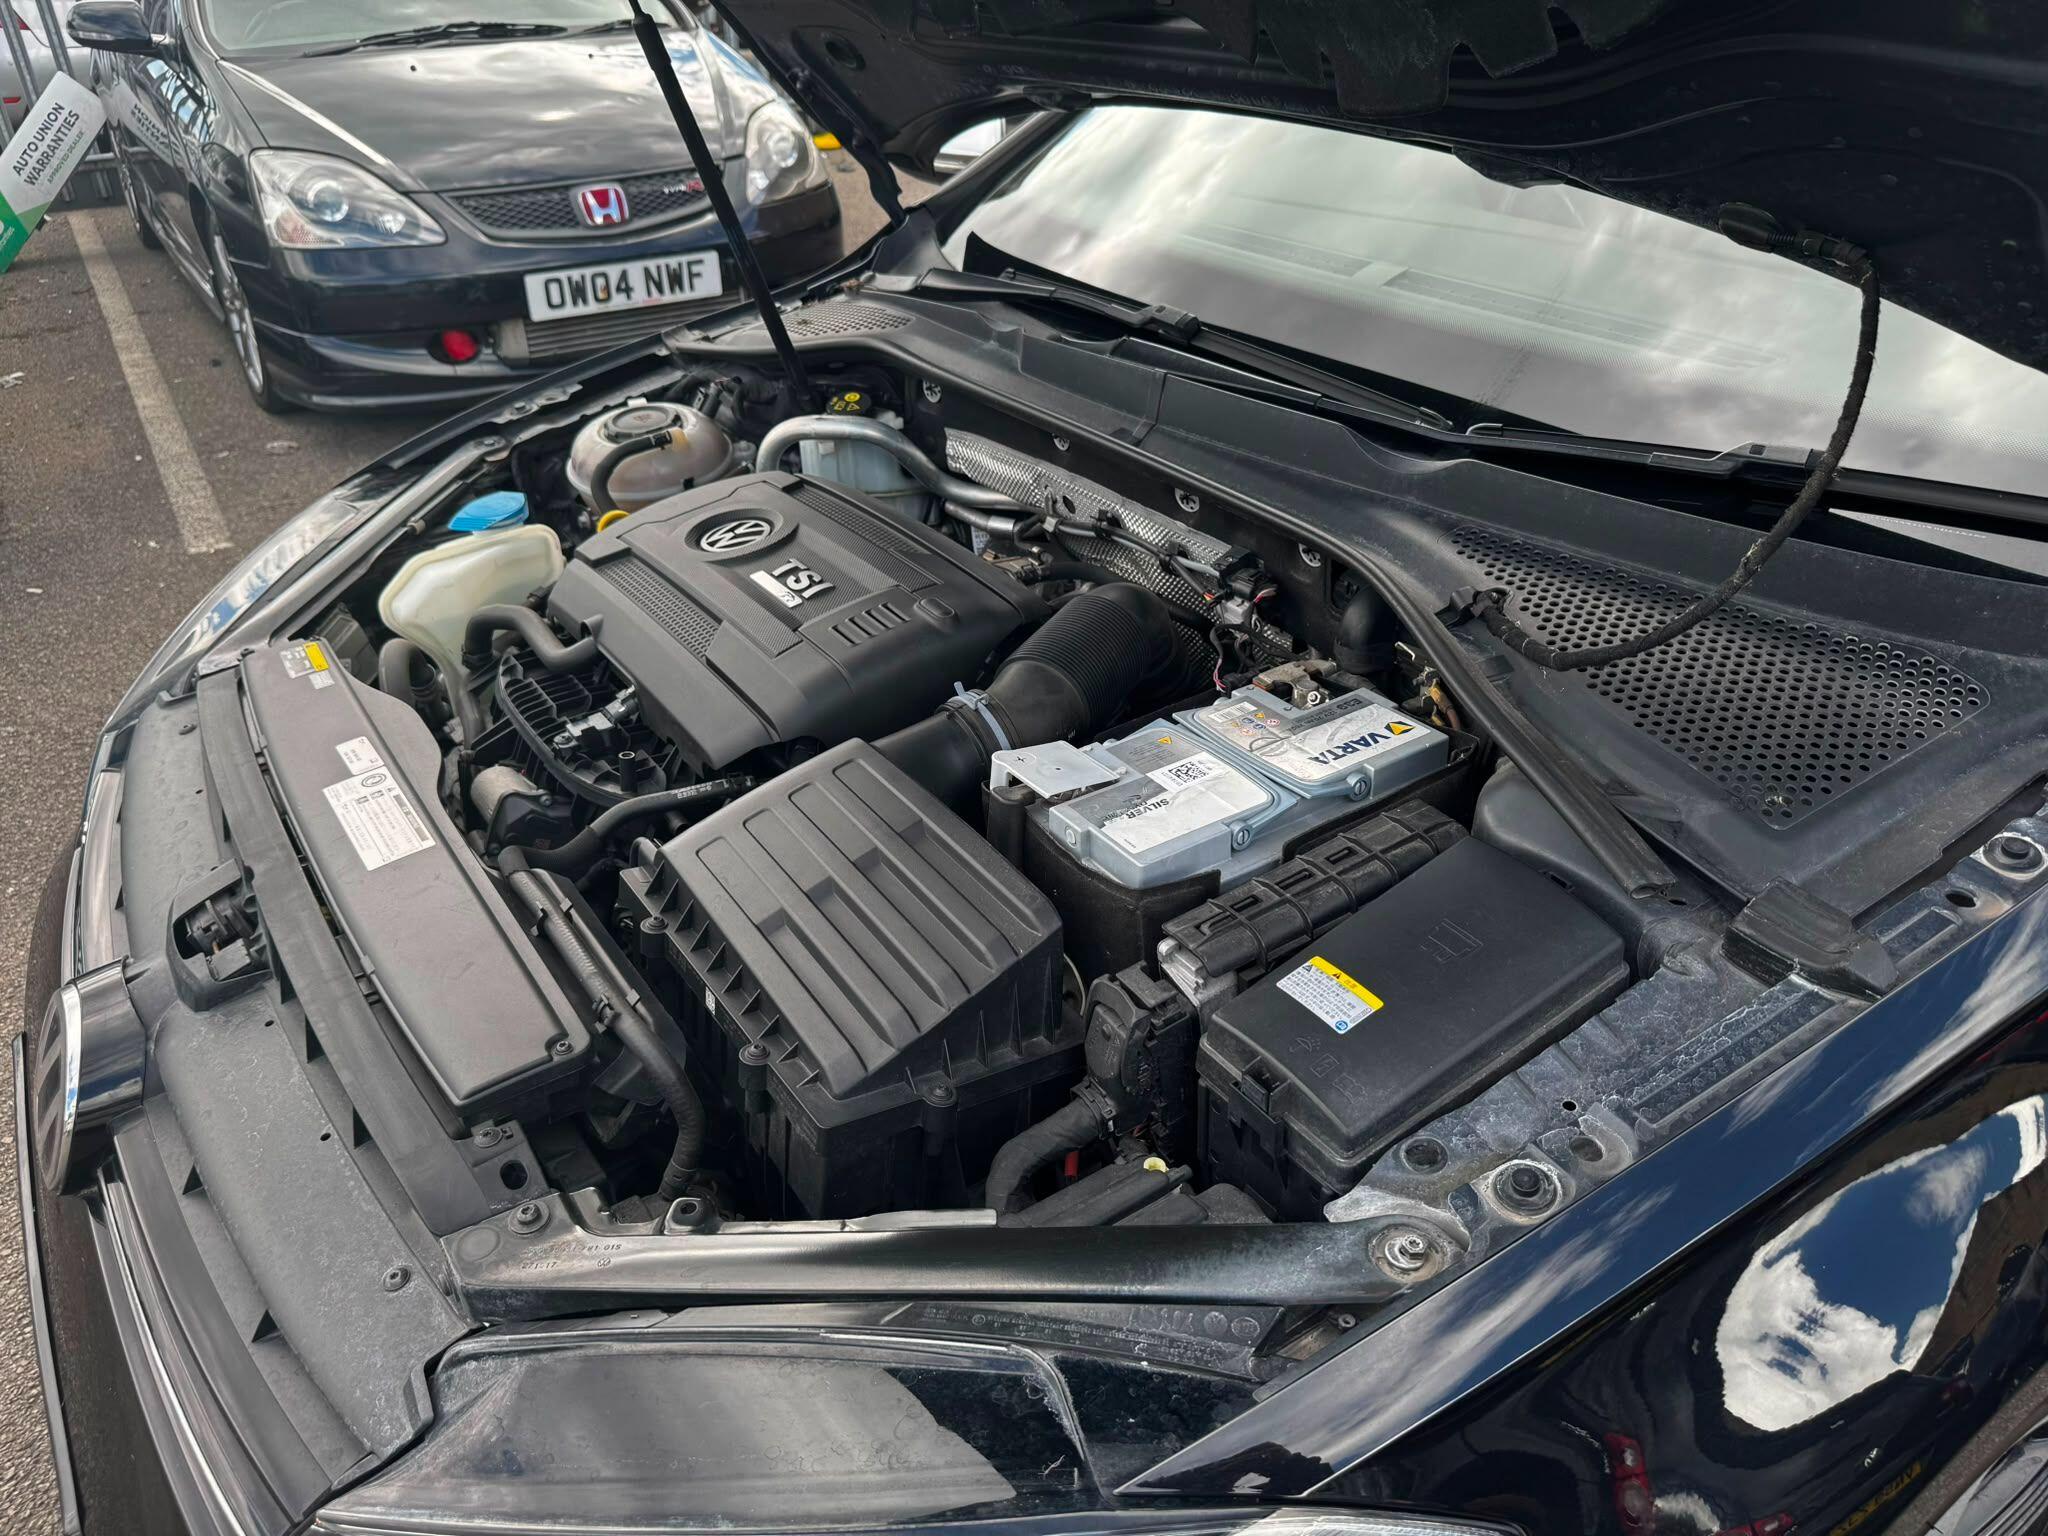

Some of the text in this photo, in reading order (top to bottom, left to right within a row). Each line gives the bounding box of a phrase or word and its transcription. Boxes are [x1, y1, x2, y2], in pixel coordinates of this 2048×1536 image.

[12, 101, 65, 176] AUTO UNION
[24, 110, 80, 187] WARRANTIES
[47, 151, 70, 185] APPROVED
[544, 260, 705, 310] OW04 NWF
[772, 558, 834, 599] TSI
[1306, 732, 1391, 765] VARTA
[1126, 798, 1170, 820] SILVER
